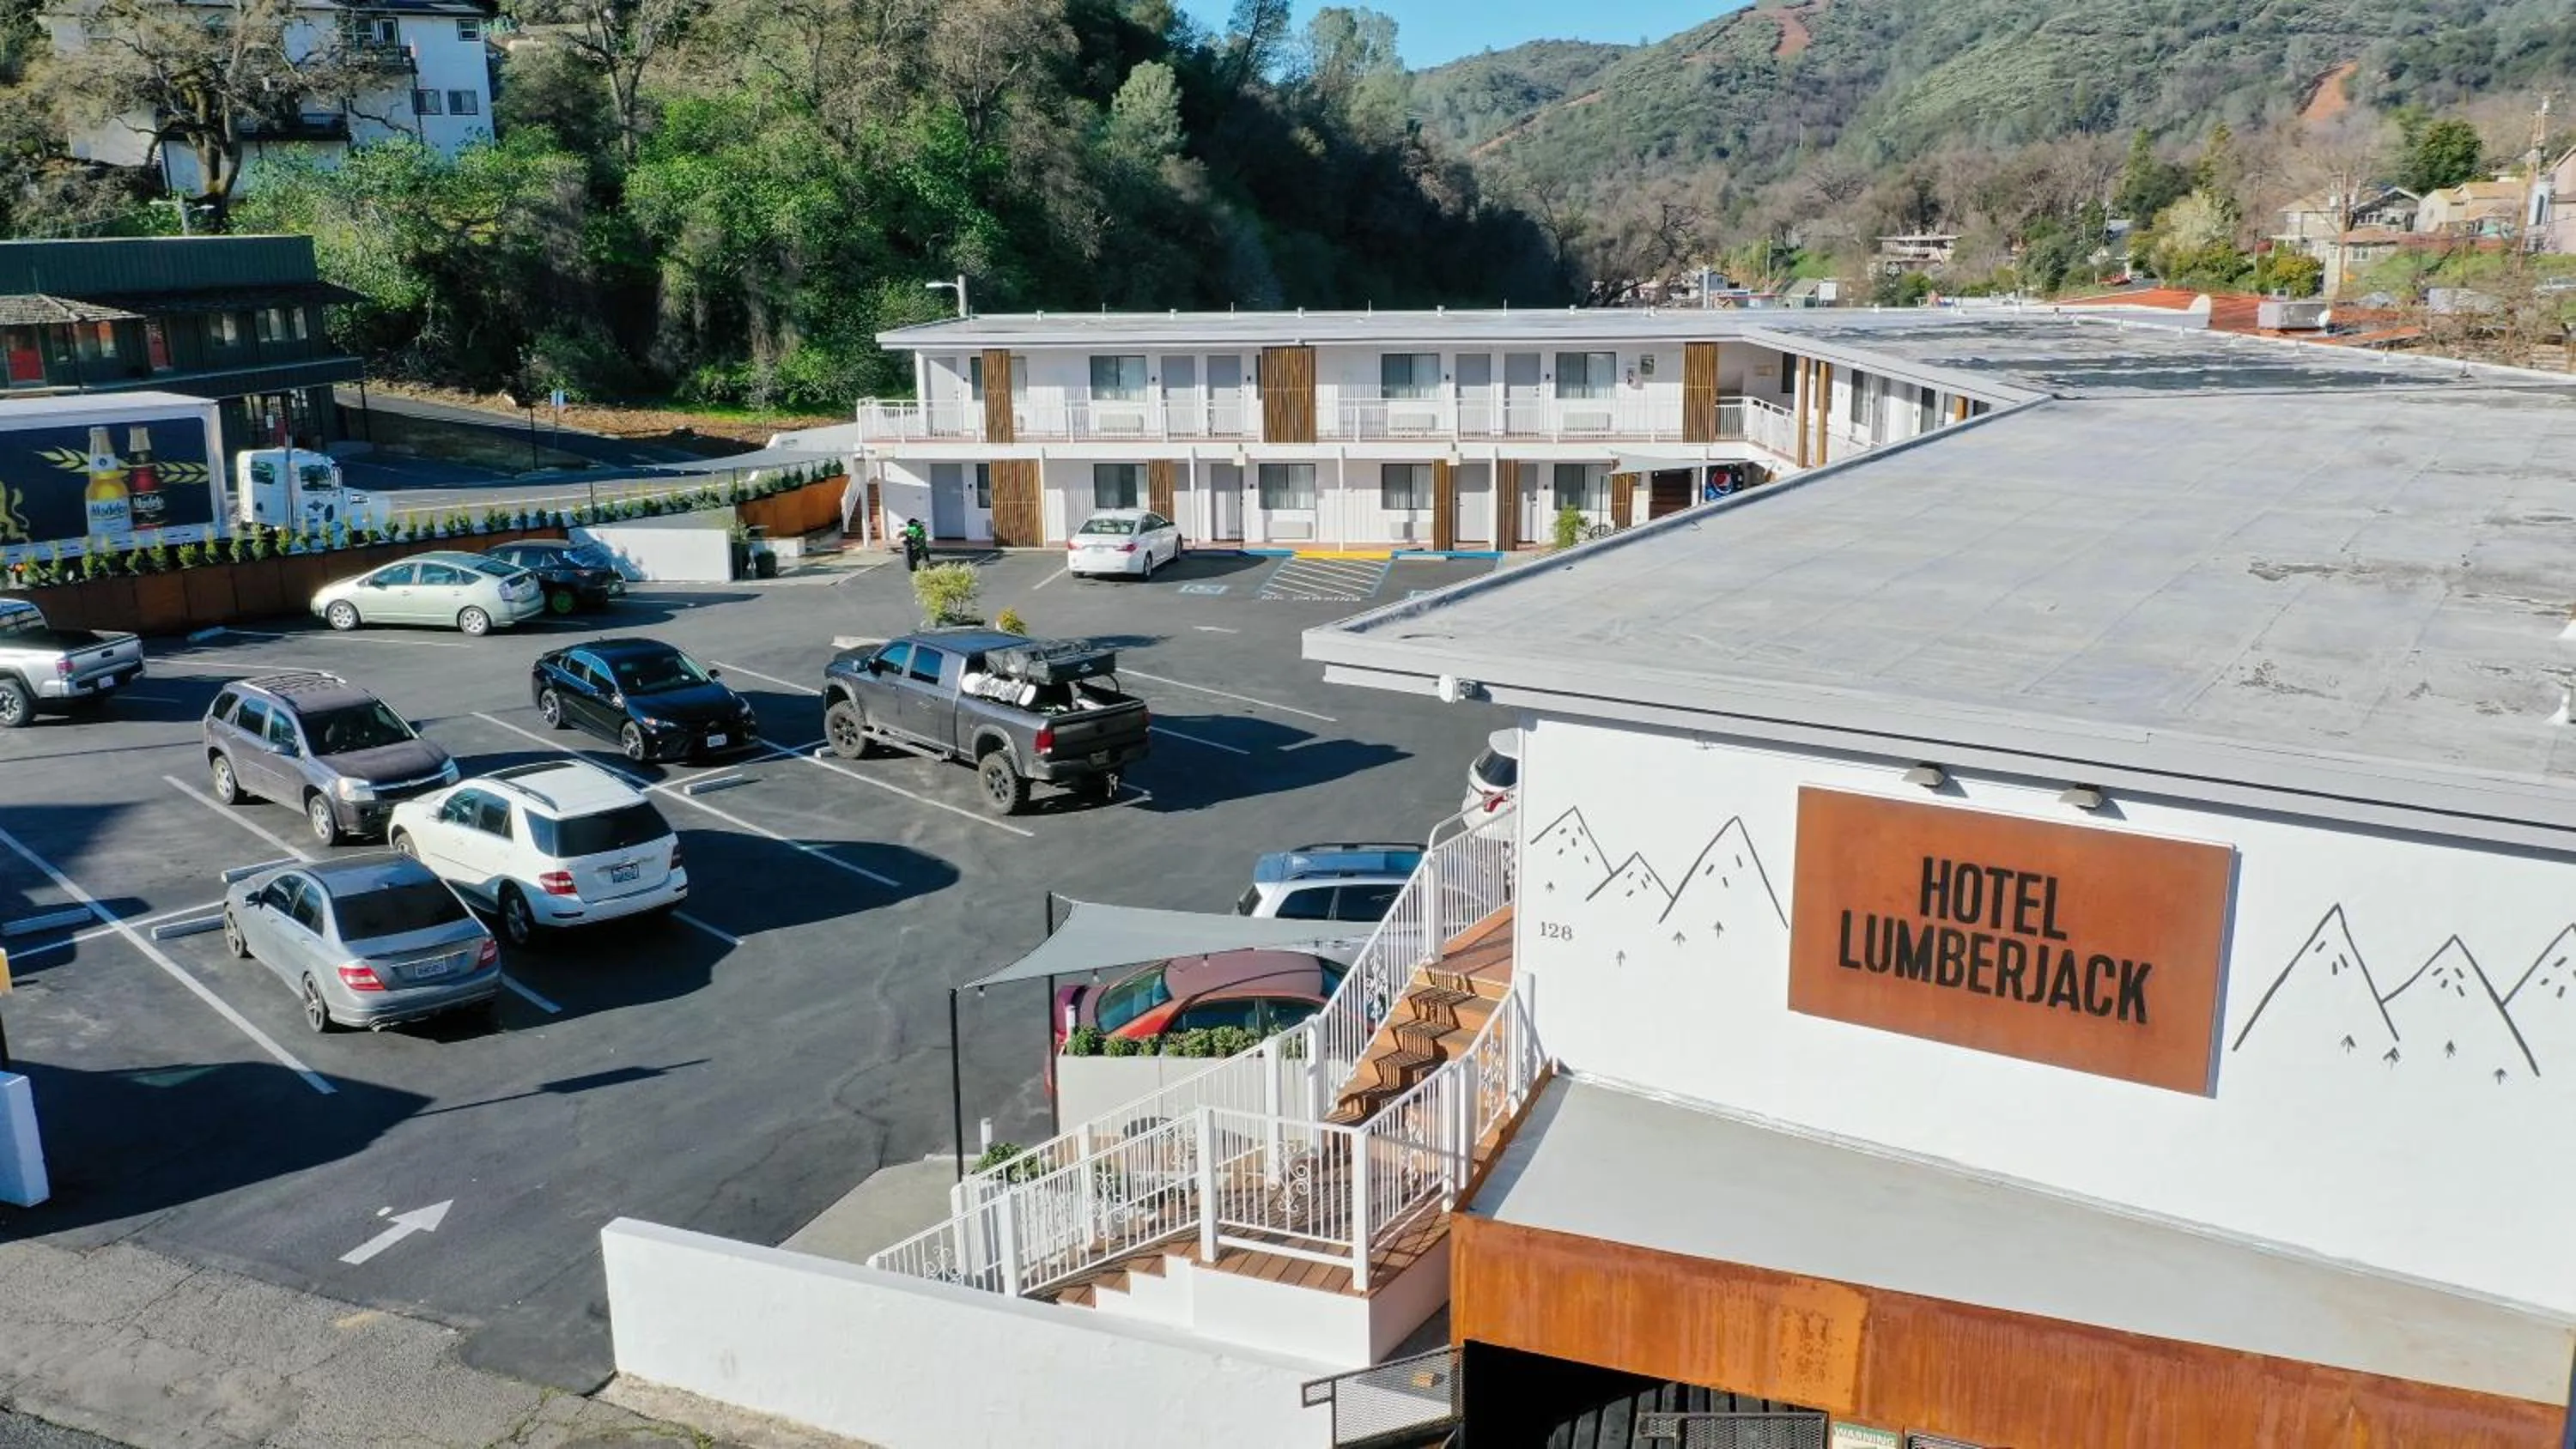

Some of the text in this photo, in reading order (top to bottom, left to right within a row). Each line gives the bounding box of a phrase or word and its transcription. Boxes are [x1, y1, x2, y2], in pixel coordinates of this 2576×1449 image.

[1919, 856, 2068, 942] HOTEL
[1540, 920, 1573, 942] 128
[1838, 909, 2154, 1026] LUMBERJACK
[1833, 1426, 1895, 1446] WARNING
